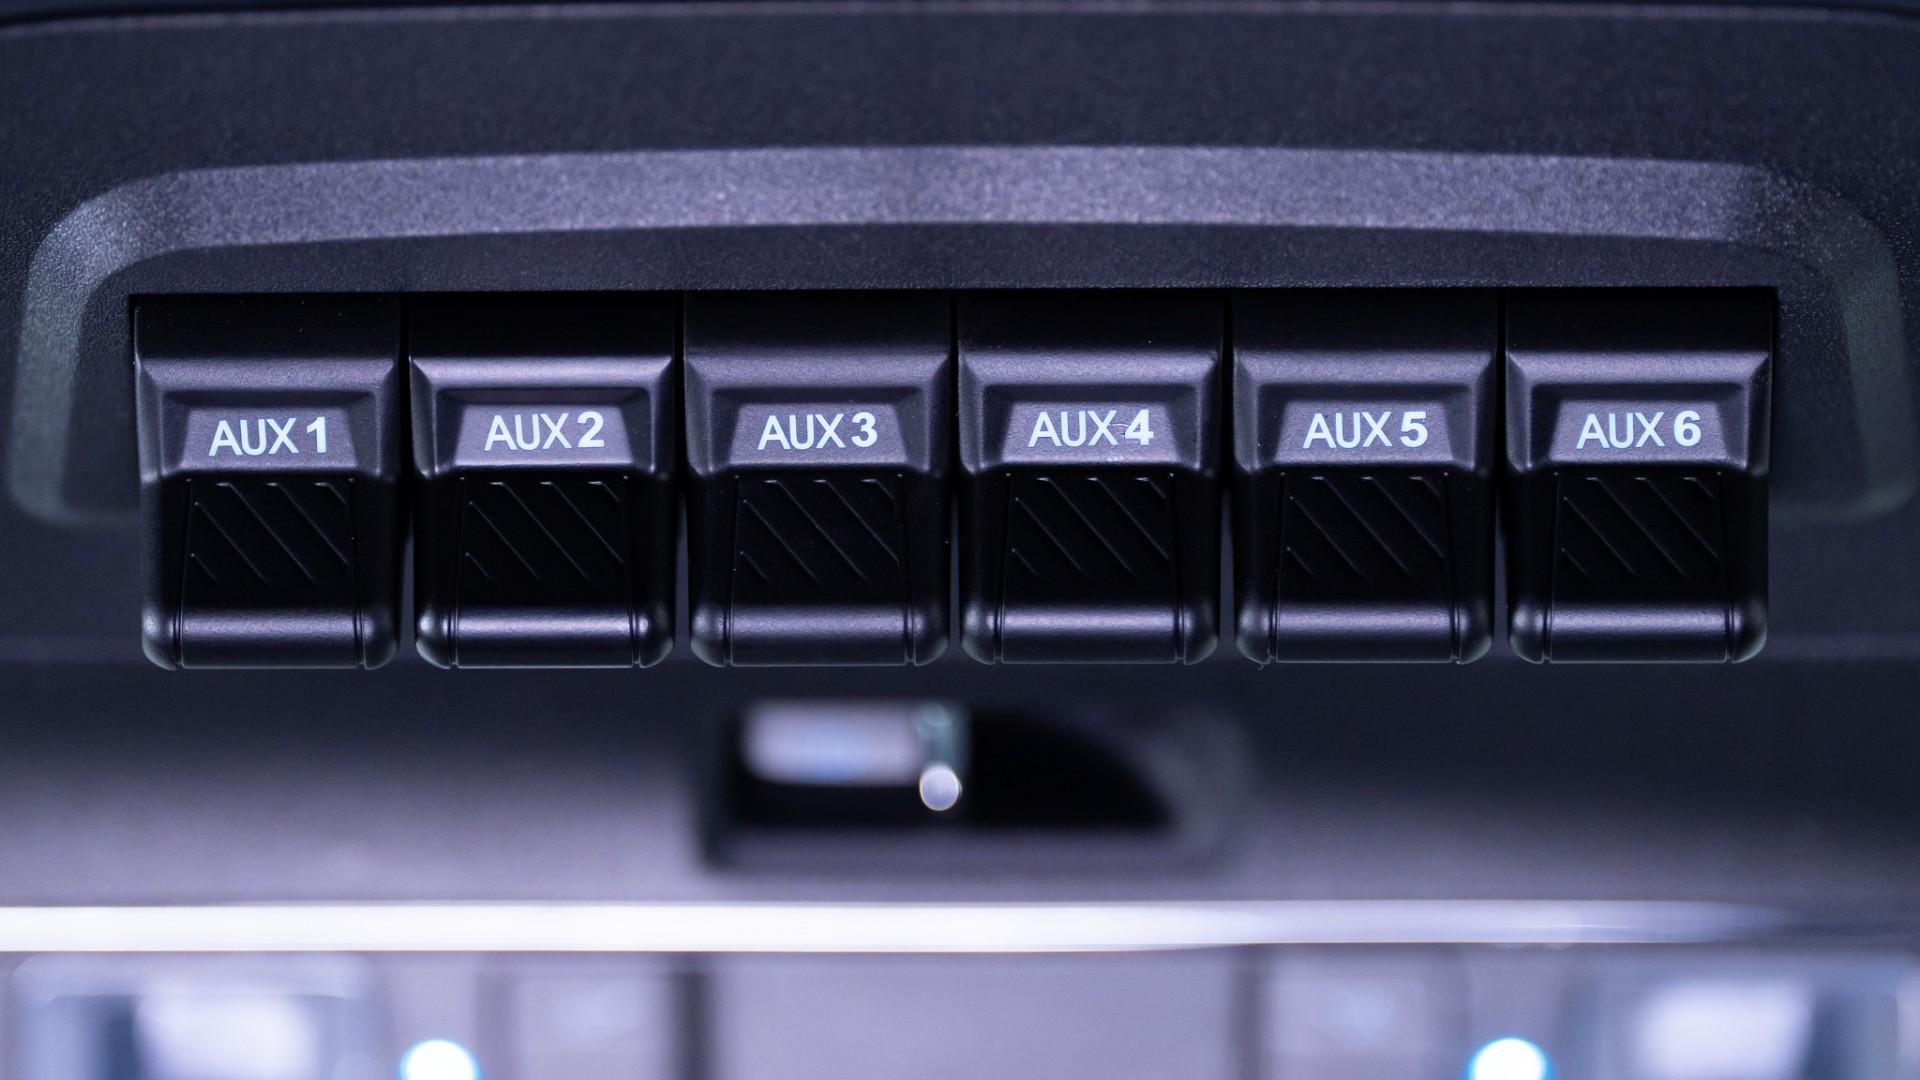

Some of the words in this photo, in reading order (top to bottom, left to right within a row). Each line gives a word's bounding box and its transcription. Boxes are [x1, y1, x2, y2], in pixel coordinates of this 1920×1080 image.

[208, 417, 300, 457] AUX
[306, 416, 328, 454] 1
[483, 412, 573, 452] AUX
[577, 410, 606, 448] 2
[756, 412, 847, 451] AUX
[850, 411, 879, 448] 3
[1026, 409, 1119, 448] AUX
[1123, 408, 1156, 446] 4
[1301, 410, 1393, 450] AUX
[1399, 410, 1429, 448] 5
[1575, 411, 1666, 450] AUX
[1672, 409, 1702, 447] 6
